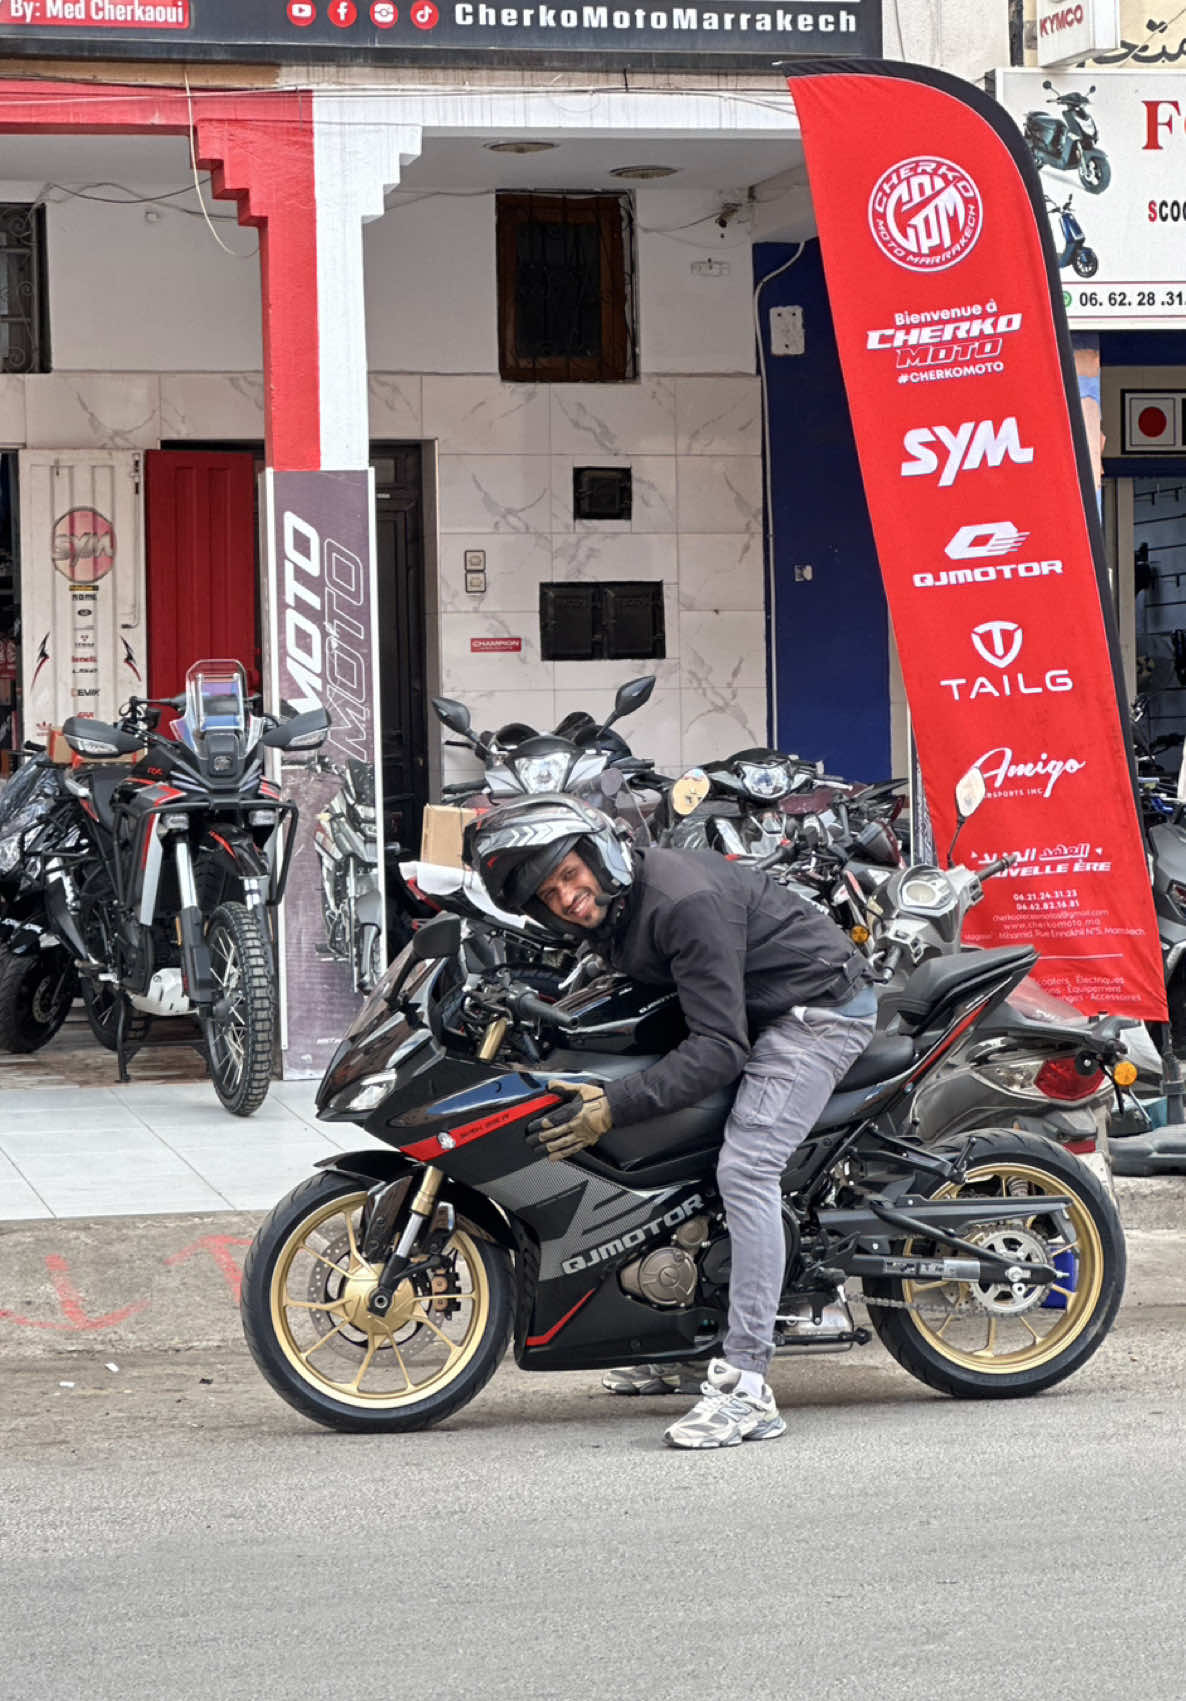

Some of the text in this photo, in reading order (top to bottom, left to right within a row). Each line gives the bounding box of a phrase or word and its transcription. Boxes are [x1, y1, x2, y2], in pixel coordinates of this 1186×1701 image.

[10, 0, 184, 23] By: Med Cherkaoui
[455, 3, 858, 33] CherkoMotoMarrakech
[1039, 4, 1084, 37] KYMCO
[1141, 100, 1186, 150] F
[873, 161, 976, 214] CHERKO
[876, 203, 977, 265] MOTO MARRAKECH
[894, 304, 983, 326] Bienvenue
[1079, 292, 1103, 306] 06.
[1108, 292, 1132, 306] 62.
[1137, 292, 1155, 306] 28
[866, 313, 1023, 350] CHERKO
[896, 337, 1003, 369] MOTO
[897, 361, 1004, 384] #CHERKOMOTO
[901, 416, 1034, 487] SYM
[912, 560, 1064, 588] QJMOTOR
[283, 511, 322, 714] MOTO
[324, 537, 367, 763] MOTO
[940, 669, 1073, 700] TAILG
[972, 747, 1086, 798] Amigo
[984, 790, 1025, 798] RSPORTS
[562, 1193, 705, 1275] QJMOTOR
